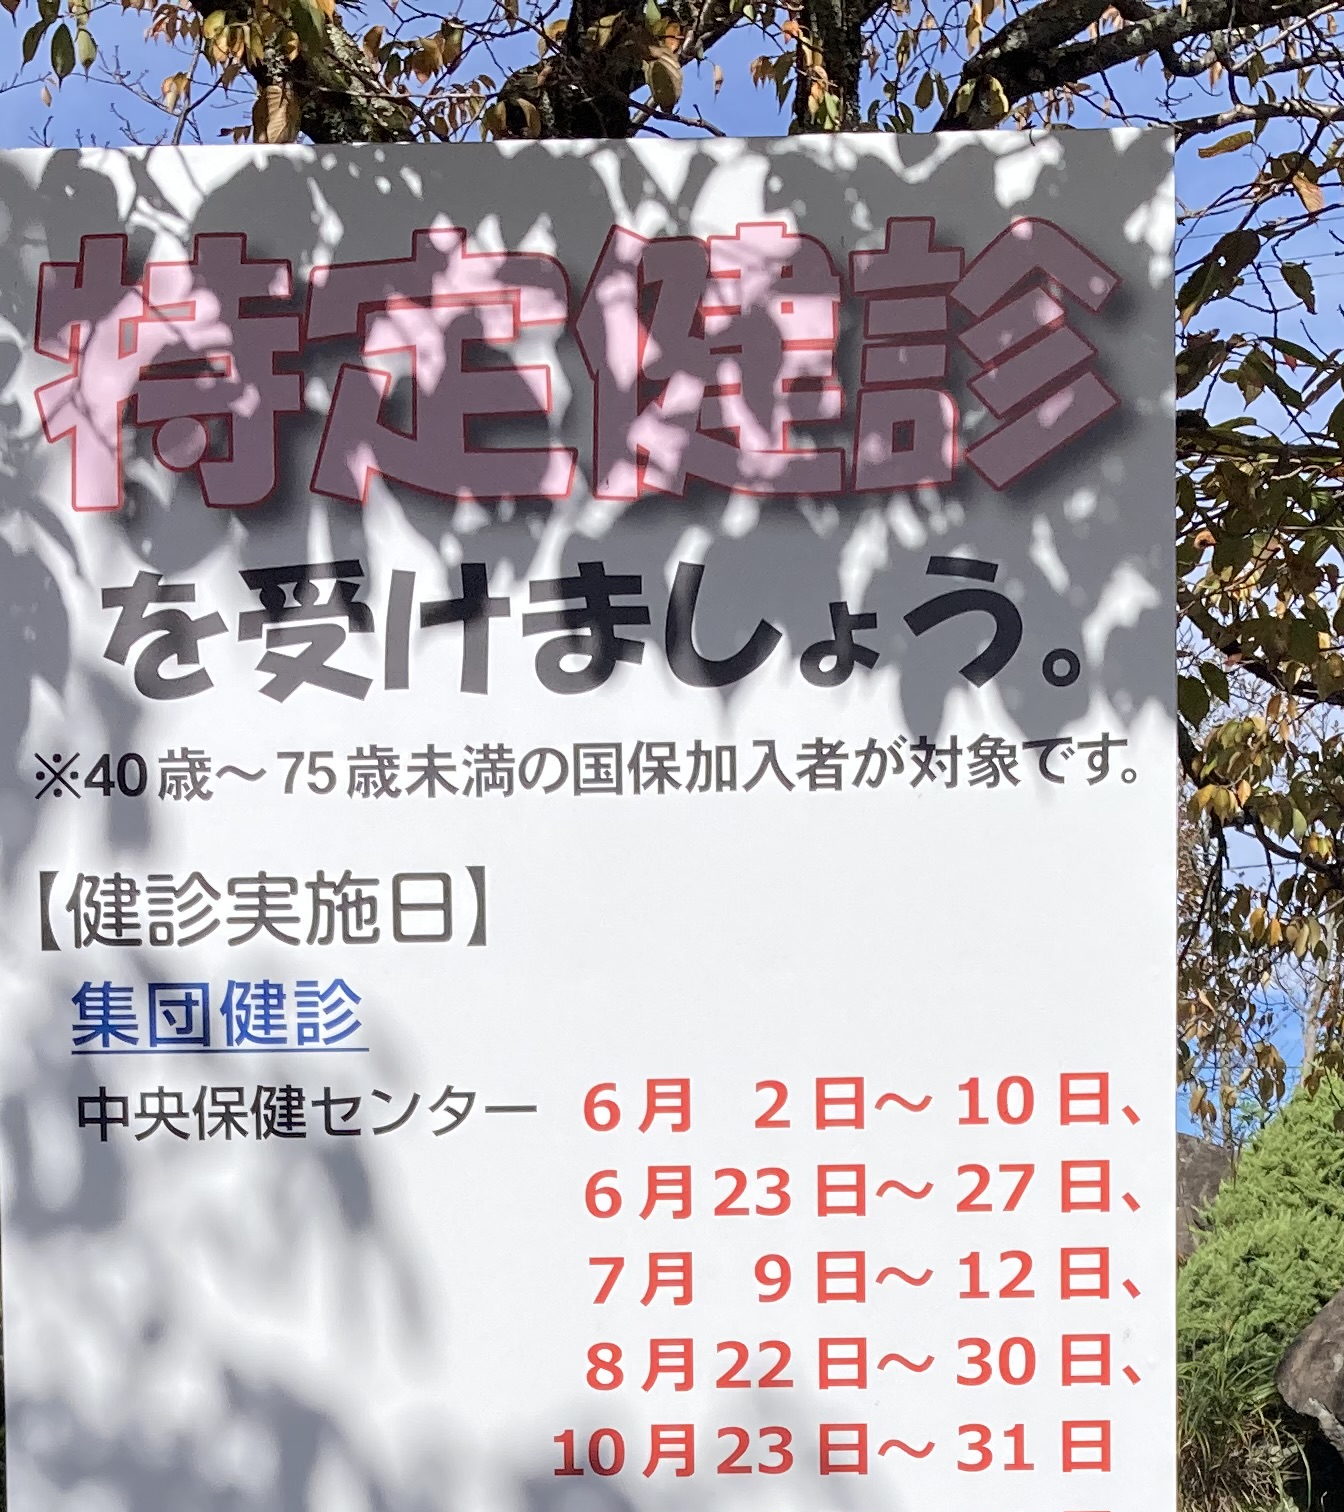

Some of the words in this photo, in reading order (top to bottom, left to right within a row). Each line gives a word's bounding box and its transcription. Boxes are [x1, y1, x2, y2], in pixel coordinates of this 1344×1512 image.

[34, 216, 1122, 511] 特定健診
[102, 555, 1081, 700] を受けましょう。
[39, 866, 486, 951] 【健診実施日】
[72, 979, 362, 1050] 集団健診
[78, 1084, 537, 1142] 中央保健センター
